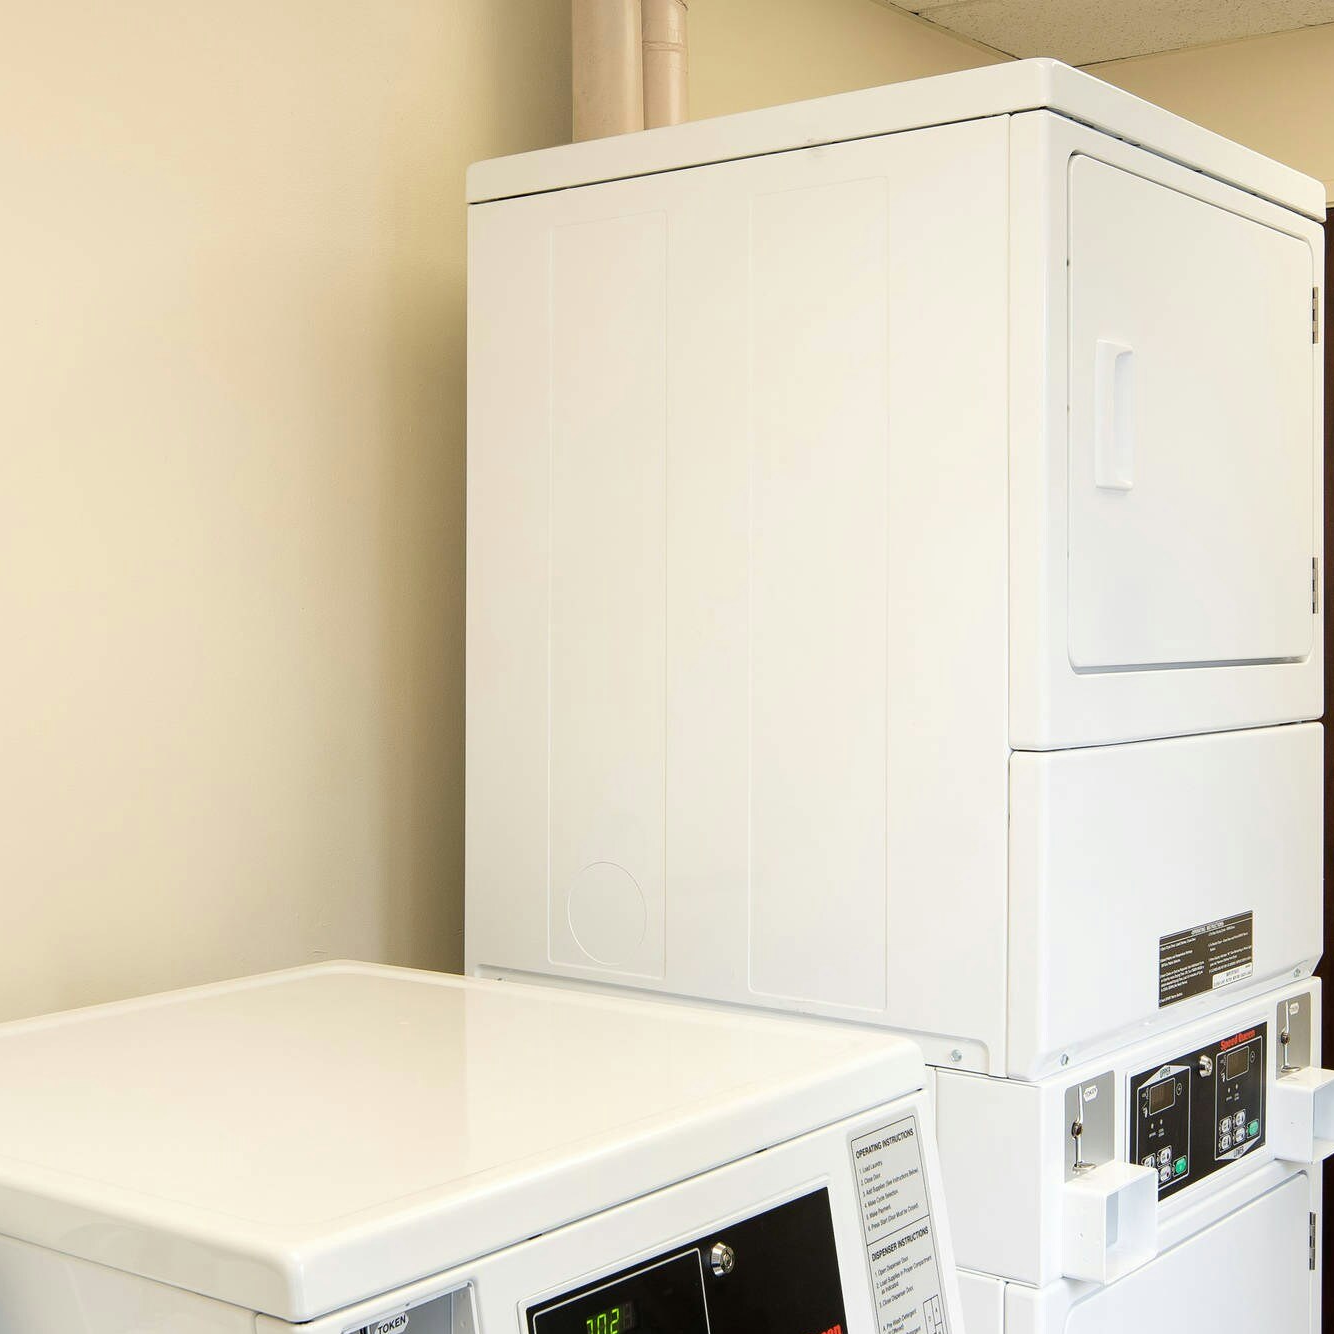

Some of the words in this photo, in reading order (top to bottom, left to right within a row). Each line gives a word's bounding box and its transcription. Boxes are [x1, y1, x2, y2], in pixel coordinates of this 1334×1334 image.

[856, 1141, 882, 1158] OPERATING
[882, 1128, 914, 1147] INSTRUCTIONS
[872, 1242, 897, 1261] DISPENSER
[898, 1227, 929, 1248] INSTRUCTIONS
